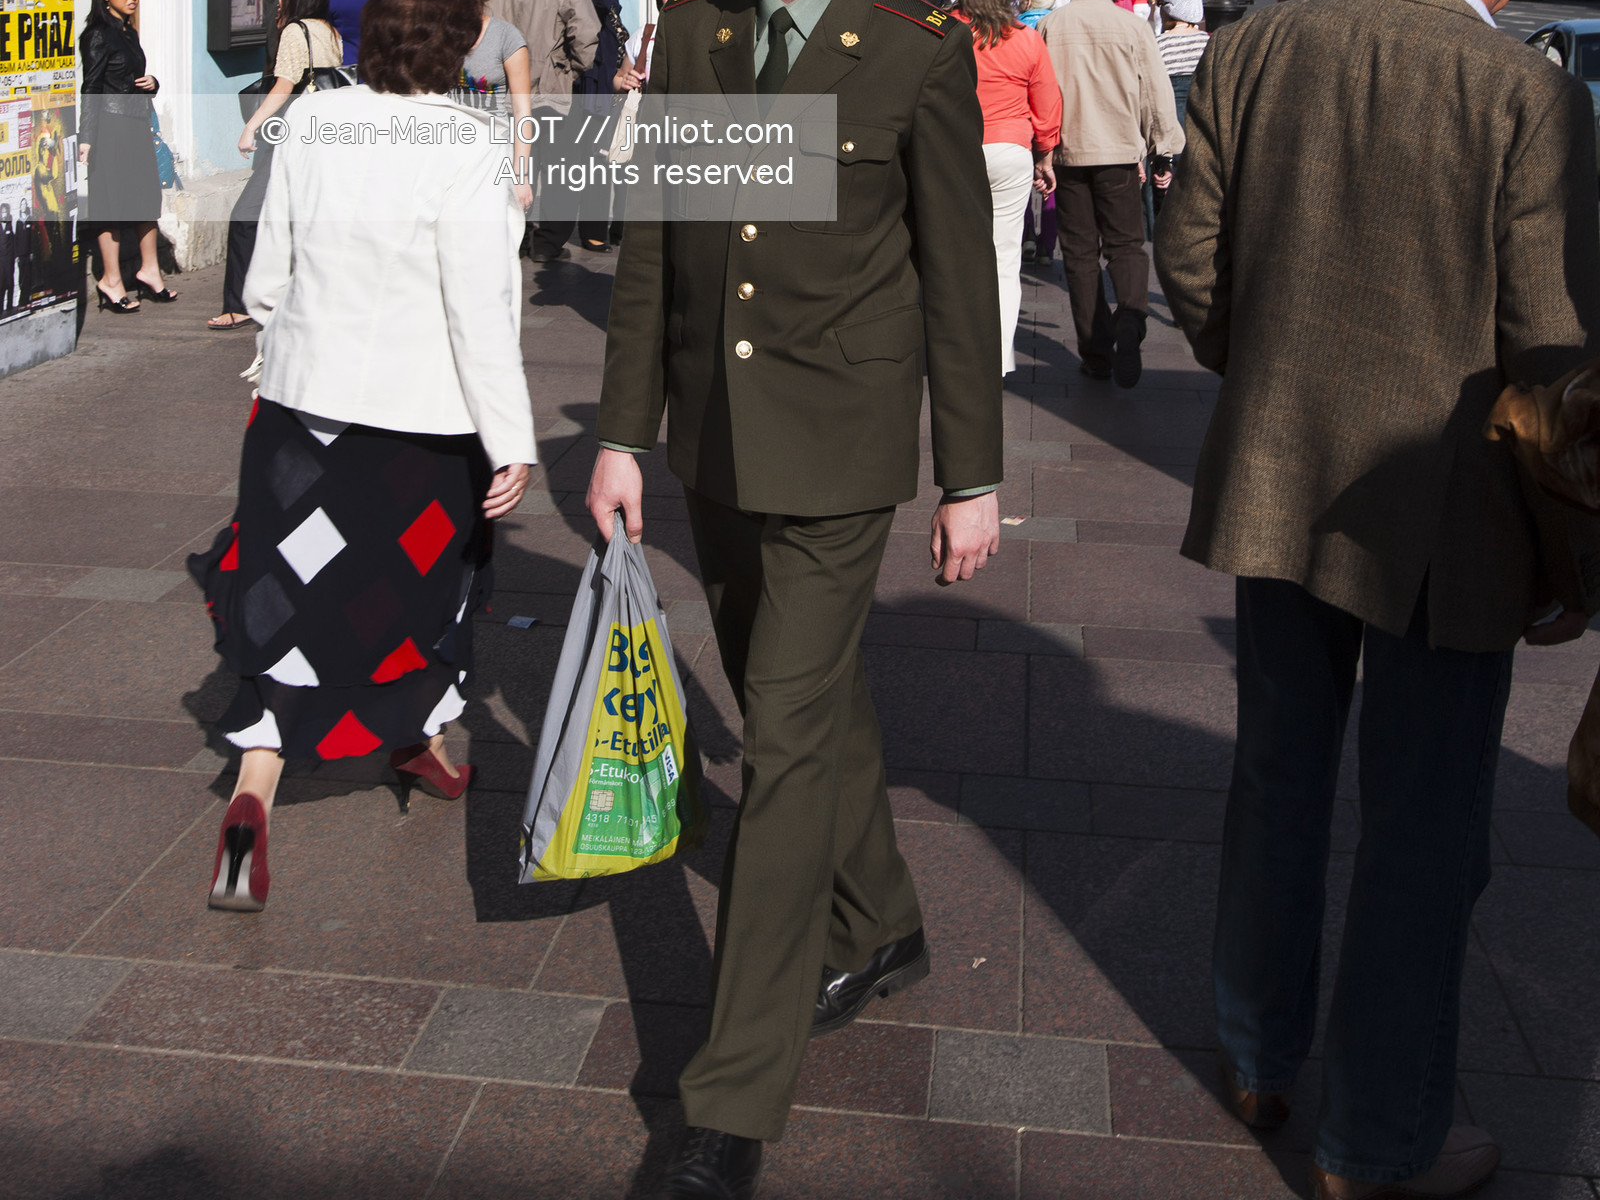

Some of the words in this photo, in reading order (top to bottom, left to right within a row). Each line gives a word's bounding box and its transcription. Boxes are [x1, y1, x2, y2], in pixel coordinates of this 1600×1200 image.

[589, 762, 643, 785] -Etuko
[584, 814, 611, 823] 4318
[579, 843, 629, 853] OSUUSKAUPPA
